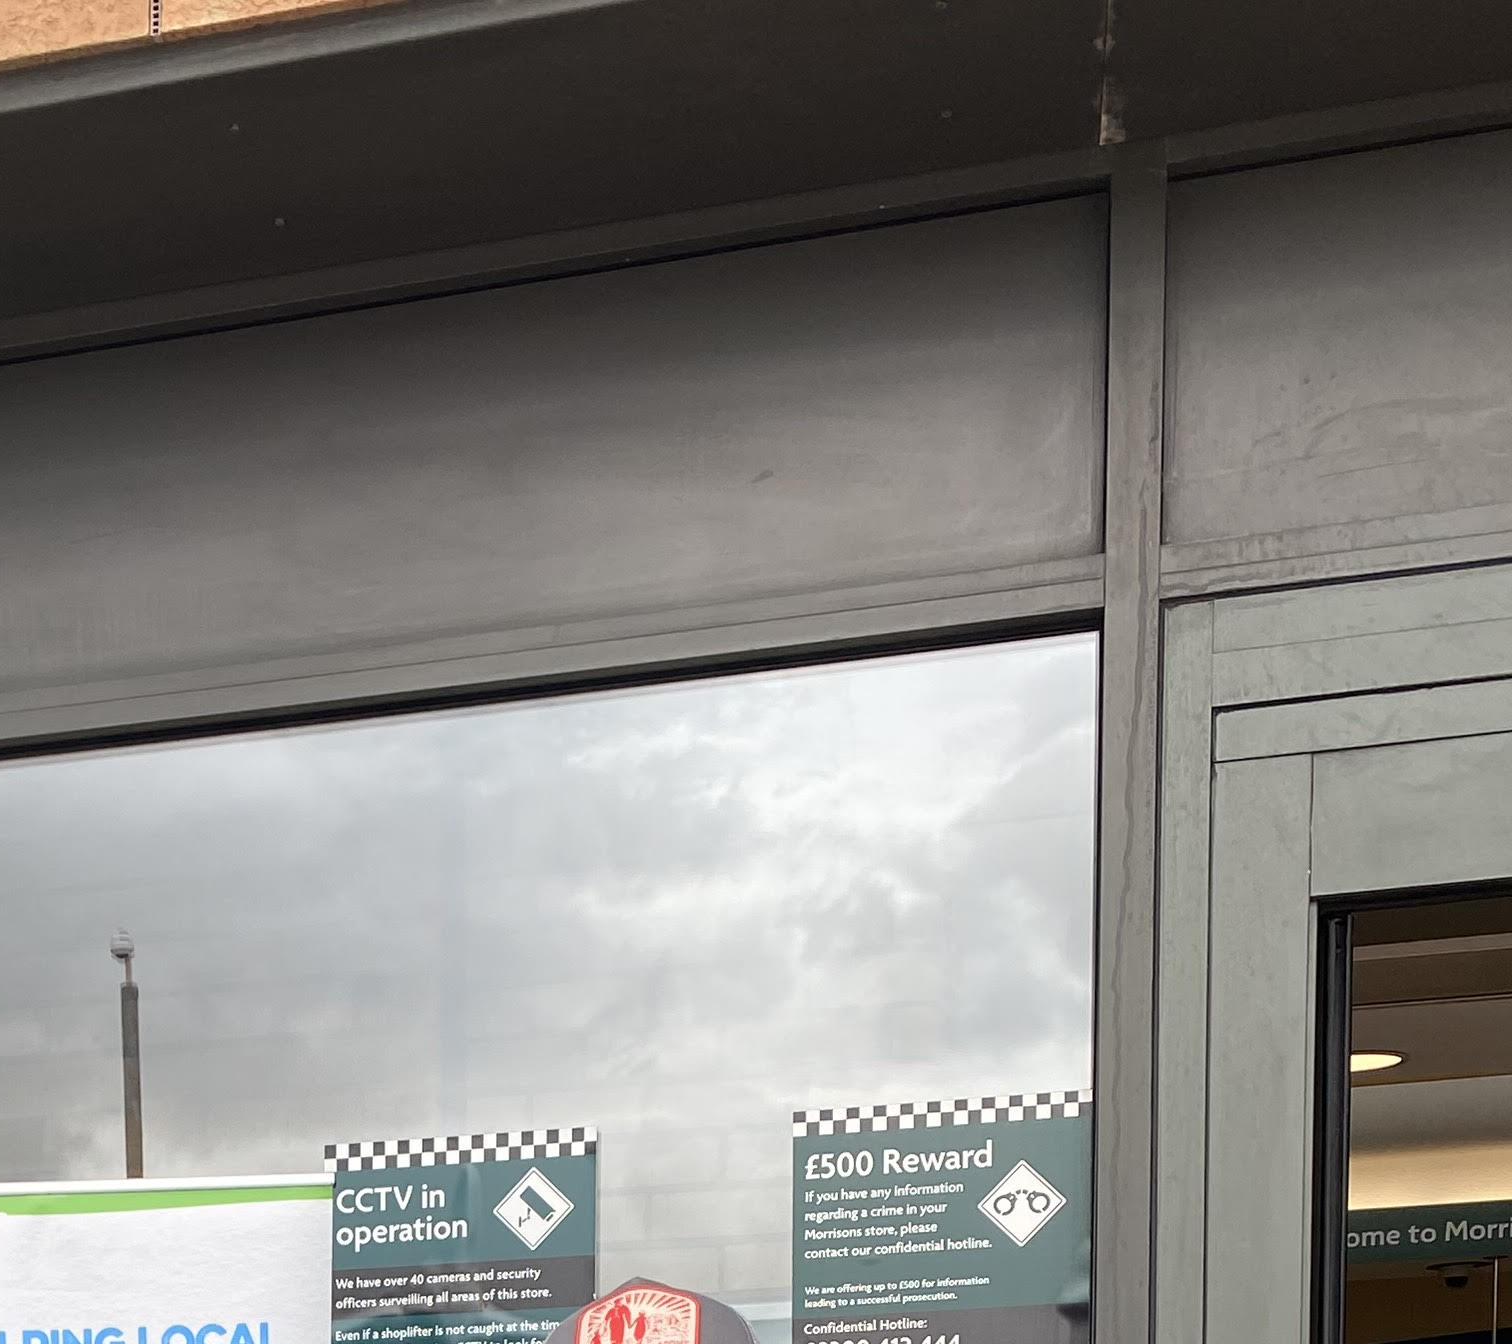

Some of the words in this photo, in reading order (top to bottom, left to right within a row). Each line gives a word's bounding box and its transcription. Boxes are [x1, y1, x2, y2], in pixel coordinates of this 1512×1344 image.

[804, 1150, 874, 1180] £500
[883, 1139, 993, 1175] Reward
[336, 1185, 413, 1214] CCTV
[421, 1183, 445, 1209] in
[804, 1190, 815, 1203] If
[816, 1192, 839, 1203] you
[840, 1187, 868, 1201] have
[870, 1188, 892, 1201] any
[894, 1181, 964, 1197] information
[804, 1207, 859, 1224] regarding
[860, 1208, 868, 1218] a
[870, 1204, 904, 1217] crime
[906, 1203, 918, 1215] in
[919, 1203, 948, 1217] your
[336, 1215, 468, 1252] operation
[804, 1227, 863, 1241] Morrisons
[864, 1225, 898, 1237] store,
[900, 1221, 938, 1238] please
[1347, 1229, 1401, 1247] ome
[1408, 1225, 1437, 1243] to
[1444, 1216, 1512, 1242] Morri
[804, 1246, 850, 1259] contact
[851, 1246, 873, 1257] our
[874, 1238, 945, 1255] confidential
[947, 1236, 993, 1251] hotline.
[335, 1278, 354, 1290] We
[356, 1276, 382, 1289] have
[383, 1277, 409, 1287] over
[410, 1273, 424, 1285] 40
[426, 1273, 471, 1284] cameras
[473, 1268, 494, 1282] and
[496, 1267, 541, 1281] security
[335, 1296, 377, 1309] officers
[378, 1292, 434, 1307] surveilling
[435, 1290, 449, 1303] all
[451, 1292, 480, 1302] areas
[482, 1288, 496, 1301] of
[497, 1287, 518, 1300] this
[520, 1288, 552, 1299] store.
[335, 1330, 360, 1342] Even
[362, 1327, 371, 1340] if
[372, 1330, 379, 1340] a
[381, 1325, 434, 1341] shoplifter
[434, 1324, 444, 1336] is
[445, 1324, 466, 1336] not
[467, 1321, 504, 1337] caught
[505, 1322, 518, 1333] at
[519, 1319, 539, 1332] the
[540, 1319, 561, 1331] tim
[803, 1319, 877, 1335] Confidential
[879, 1317, 928, 1331] Hotline:
